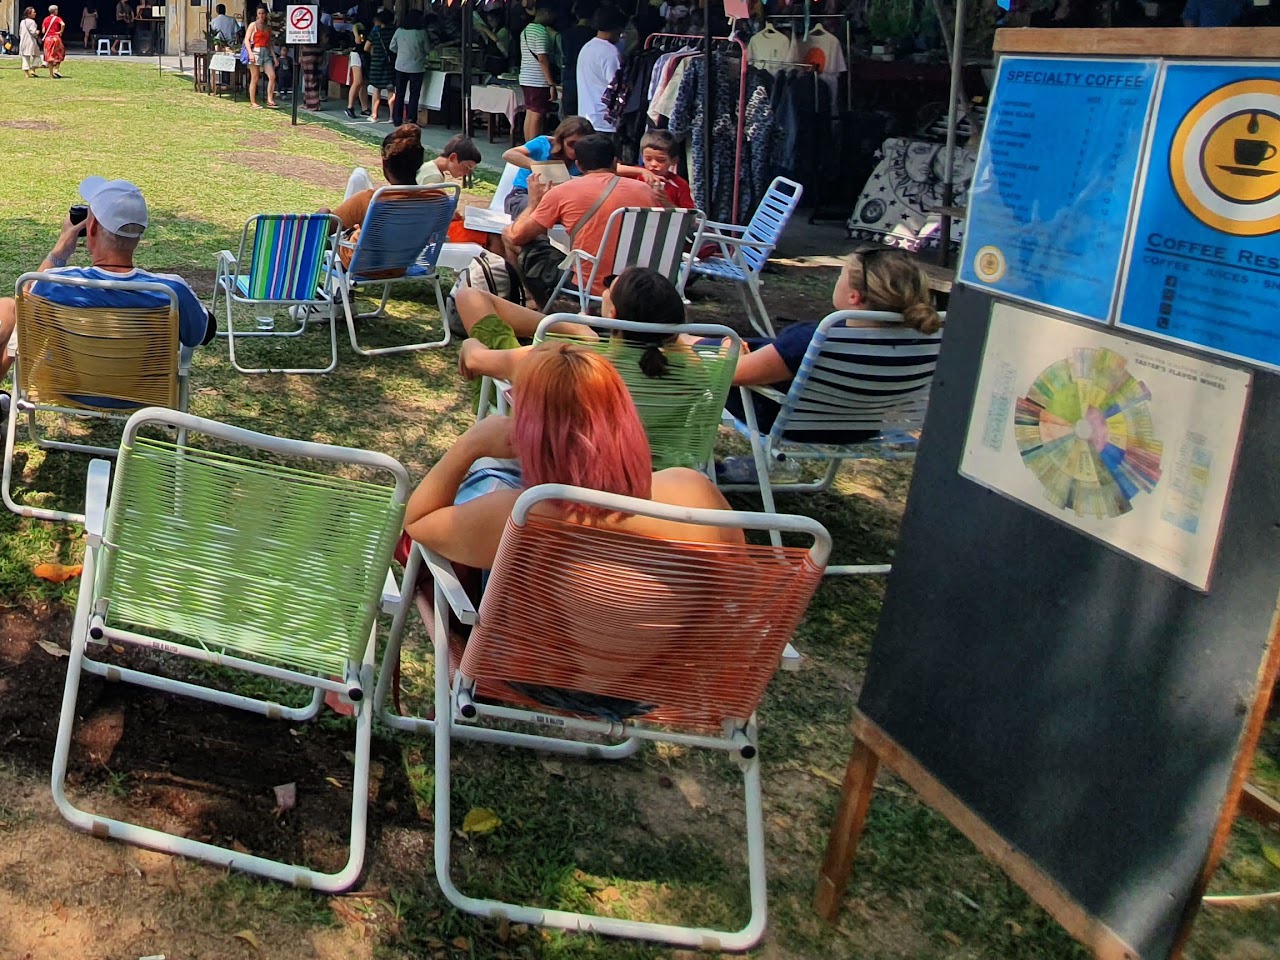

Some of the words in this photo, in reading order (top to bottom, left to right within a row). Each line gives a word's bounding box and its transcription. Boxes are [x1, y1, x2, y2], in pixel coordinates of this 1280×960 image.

[1007, 70, 1081, 85] SPECIALTY
[1085, 73, 1144, 88] COFFEE
[1143, 255, 1191, 272] COFFEE
